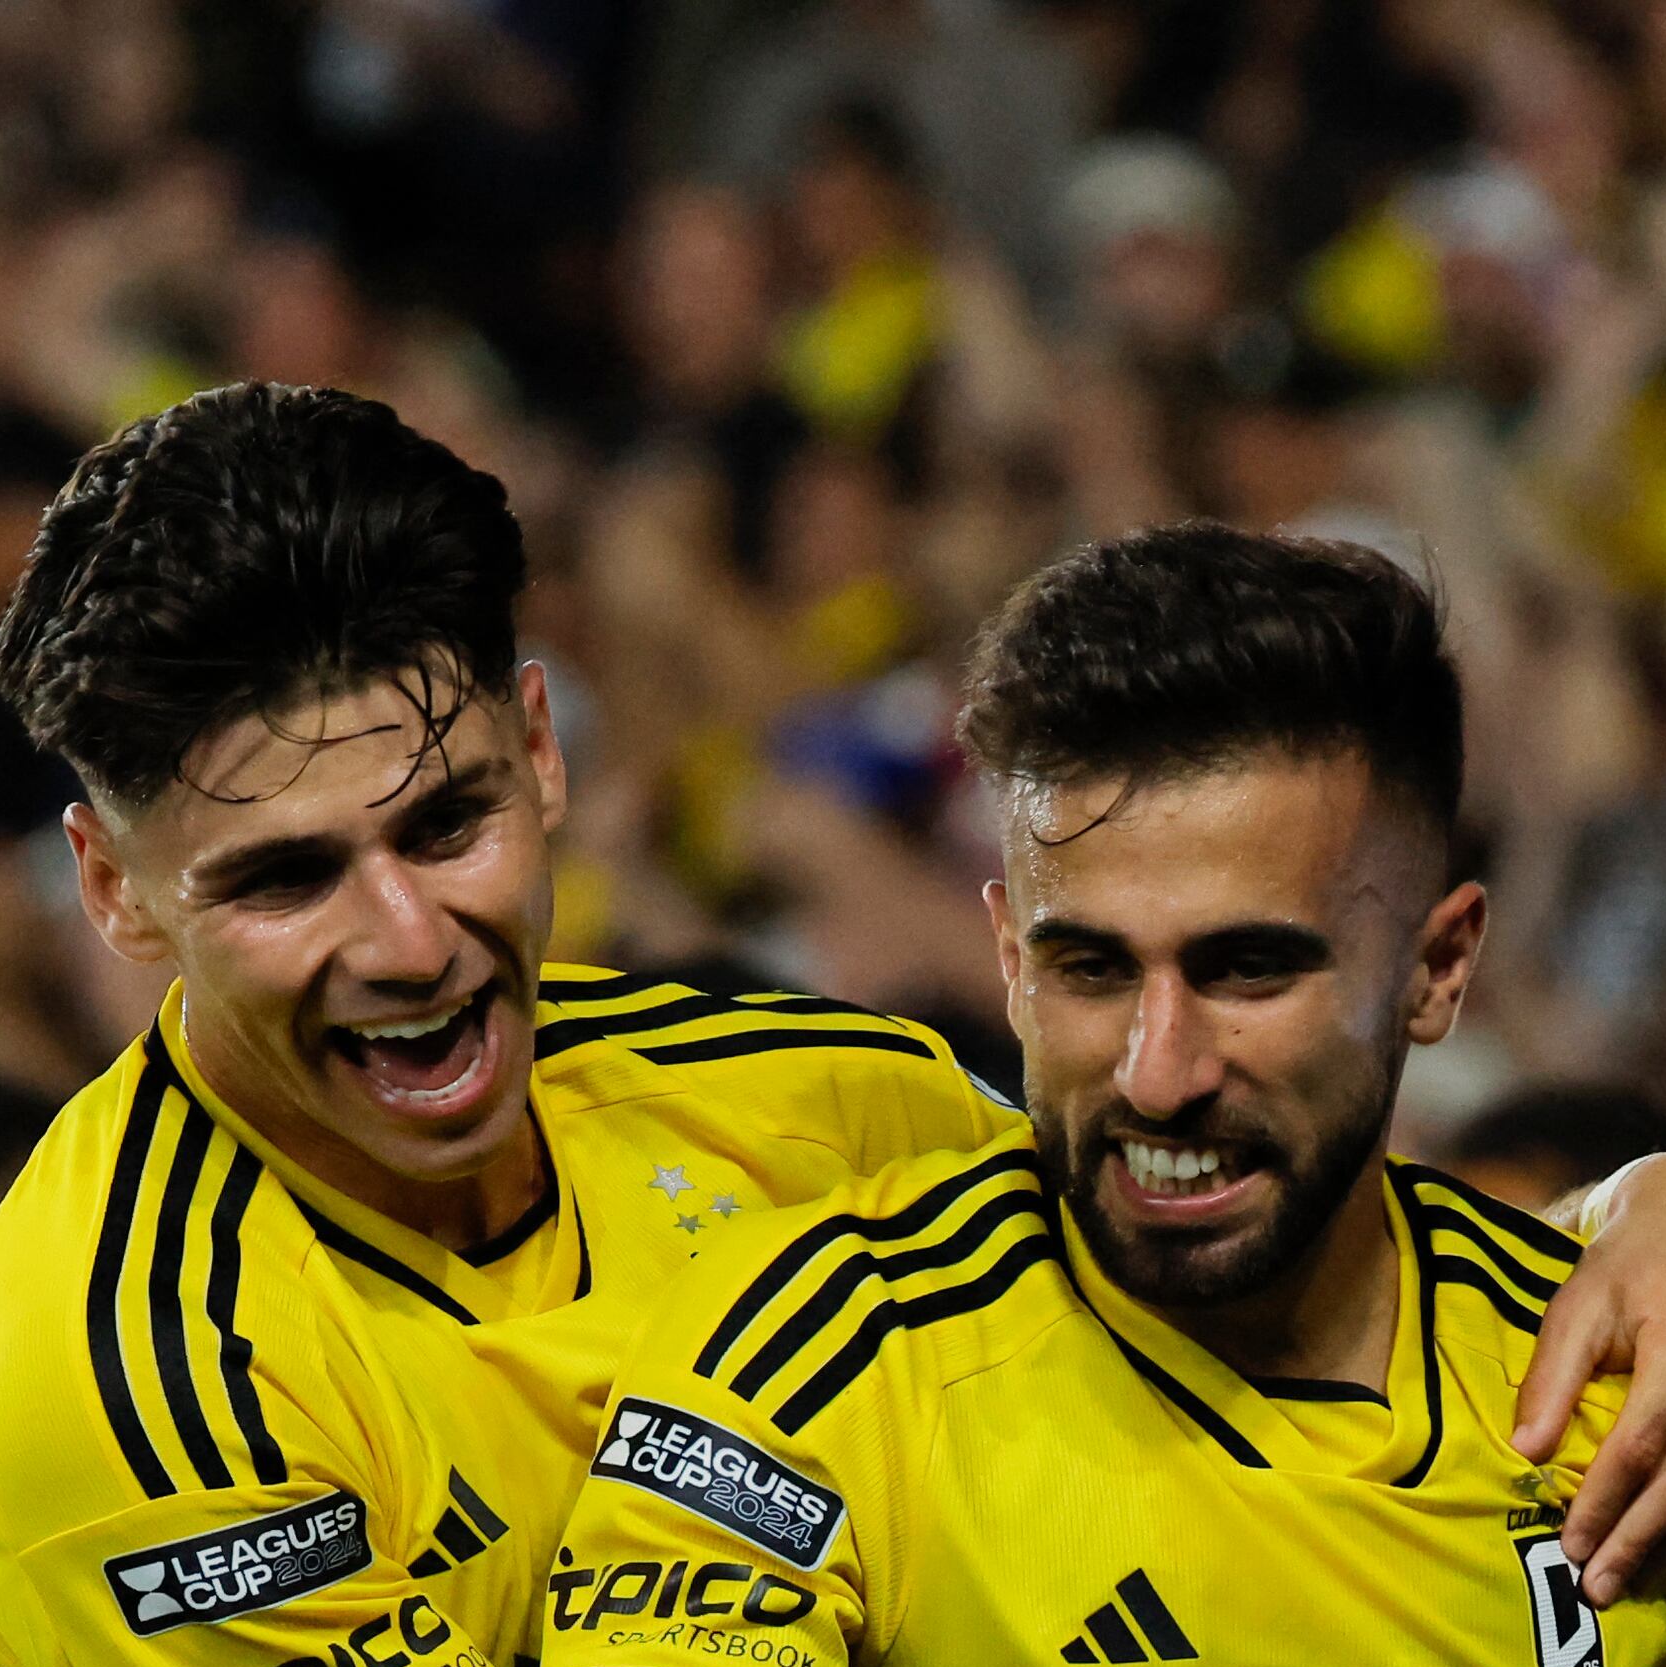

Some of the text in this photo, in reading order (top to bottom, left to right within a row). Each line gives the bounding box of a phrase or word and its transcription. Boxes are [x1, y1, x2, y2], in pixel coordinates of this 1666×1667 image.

[632, 1446, 812, 1550] CUP 2024
[644, 1417, 829, 1526] LEAGUES
[171, 1502, 357, 1586] LEAGUES
[183, 1530, 363, 1611] CUP 2024
[548, 1546, 818, 1632] tpico
